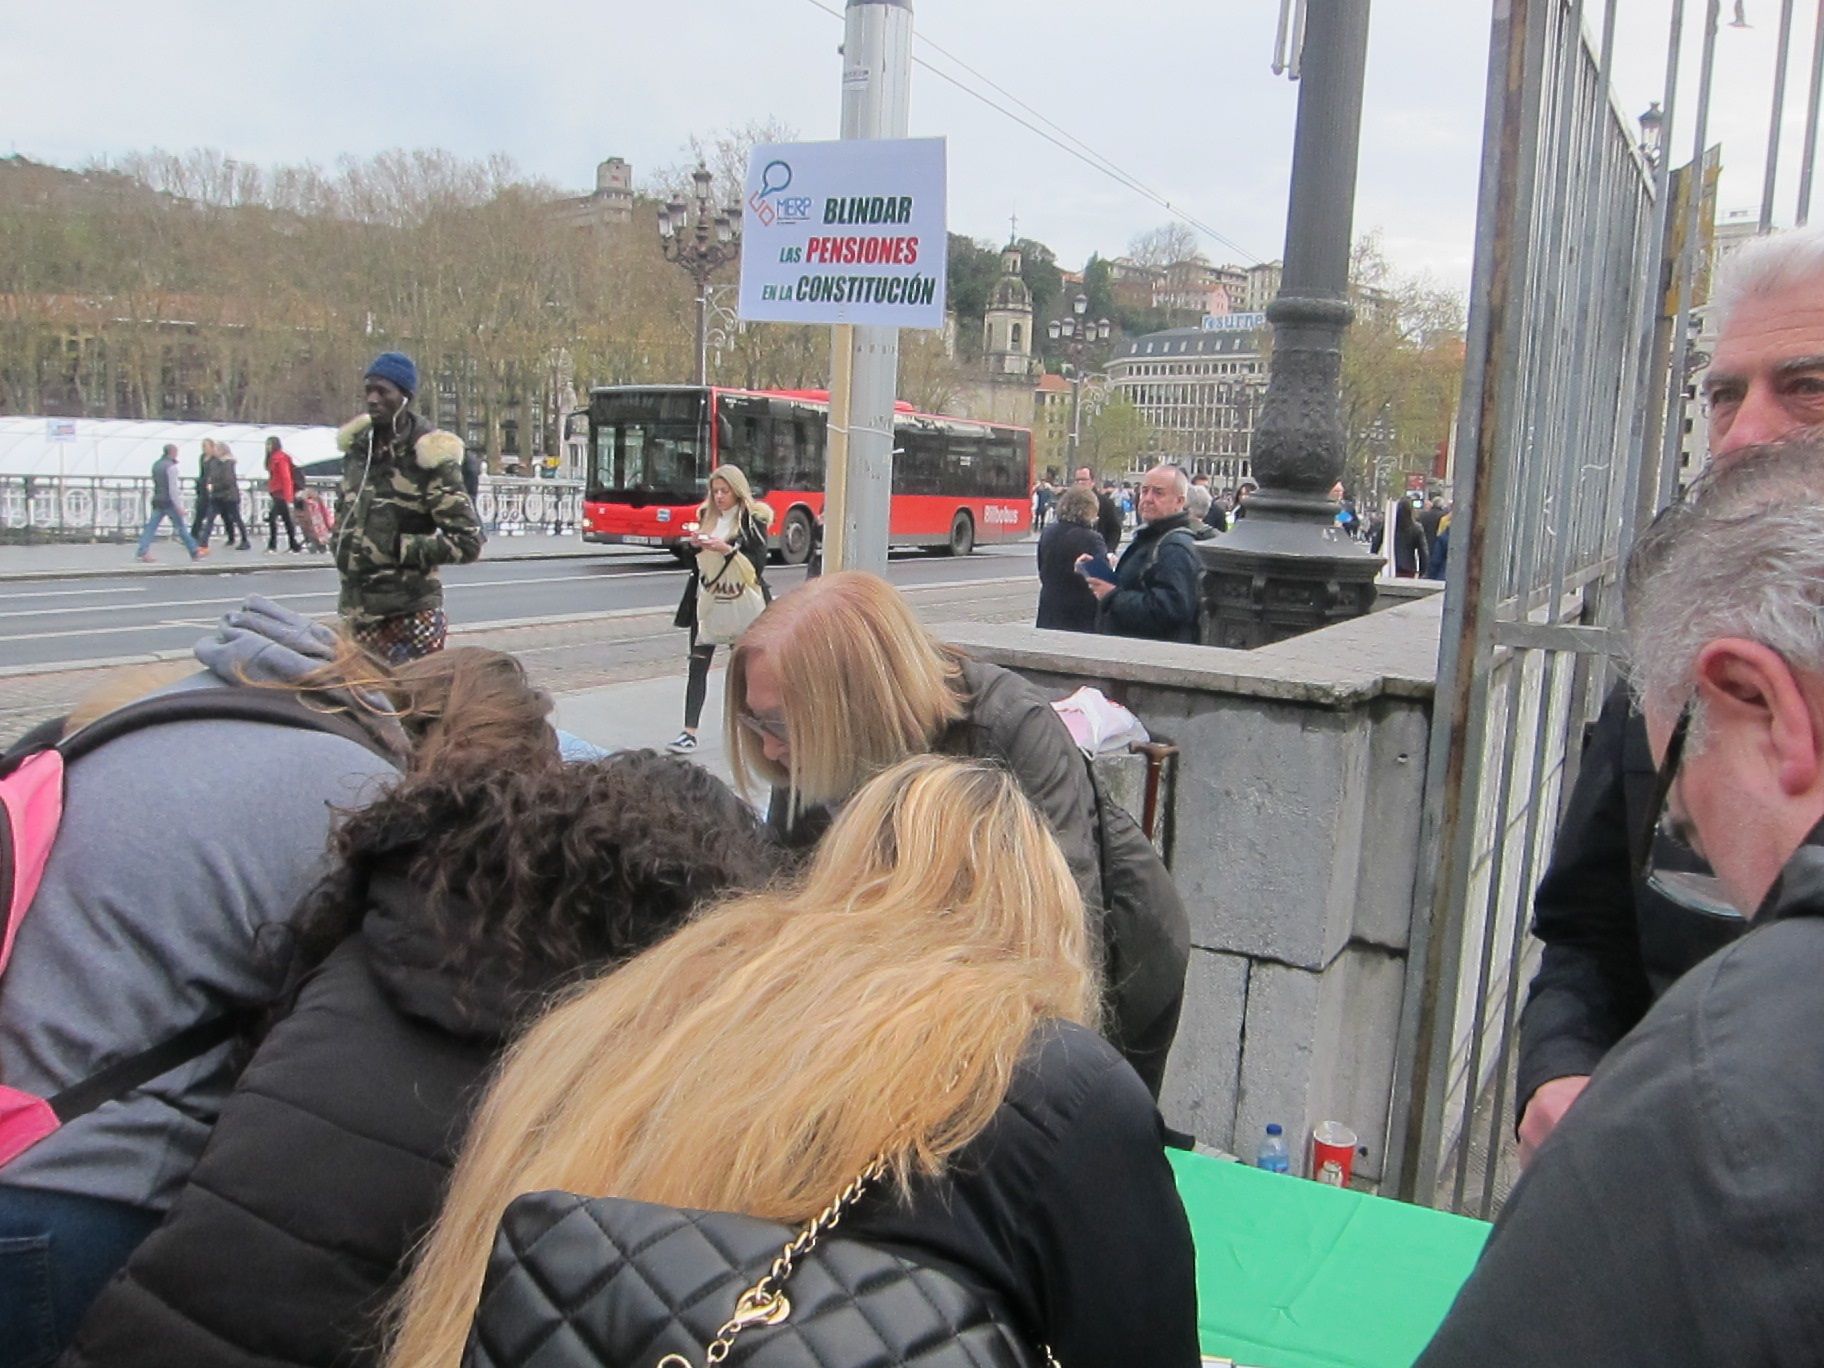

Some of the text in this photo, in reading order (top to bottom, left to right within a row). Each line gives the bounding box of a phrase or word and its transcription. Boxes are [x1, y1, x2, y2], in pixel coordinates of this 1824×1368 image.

[776, 197, 811, 215] MERP
[823, 197, 913, 225] BLINDAR
[780, 237, 919, 264] LAS PENSIONES
[762, 273, 936, 305] EN LA CONSTITUCIÓN
